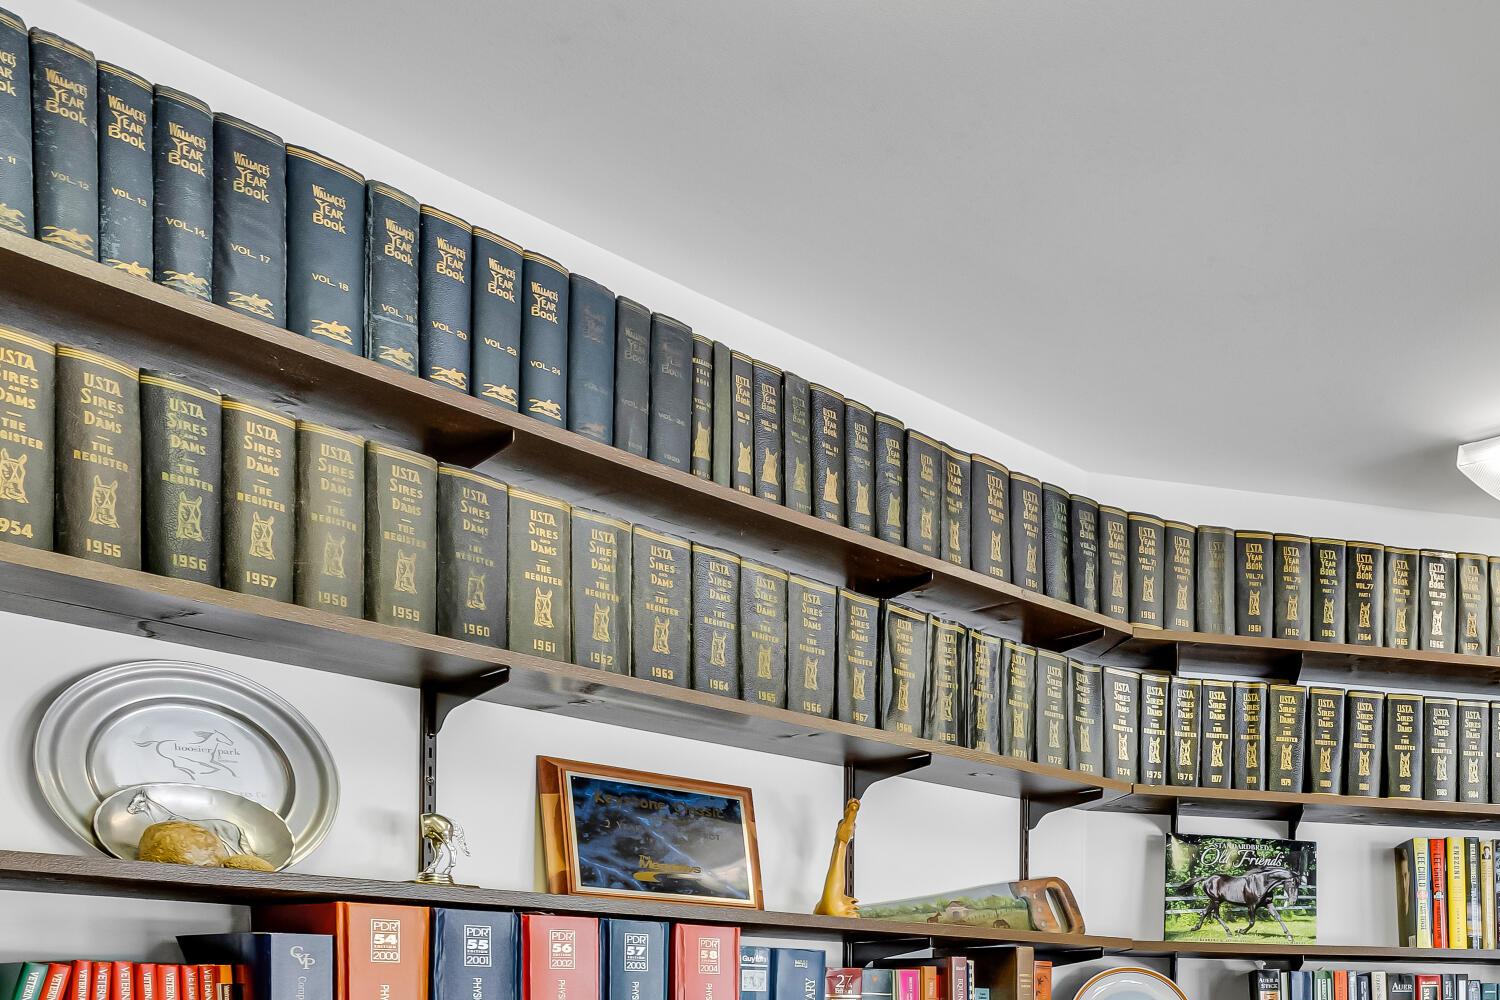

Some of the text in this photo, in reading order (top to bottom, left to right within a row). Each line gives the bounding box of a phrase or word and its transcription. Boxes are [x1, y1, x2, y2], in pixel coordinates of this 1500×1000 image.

[112, 111, 144, 135] YEAR
[108, 123, 145, 151] Book
[236, 166, 267, 188] YEAR
[233, 179, 269, 203] Book
[315, 199, 343, 220] YEAR
[313, 212, 346, 234] Book
[439, 251, 463, 271] YEAR
[436, 261, 465, 283] Book
[533, 295, 556, 312] YEAR
[531, 304, 558, 324] Book
[83, 373, 123, 398] USTA
[80, 388, 124, 414] SIRES
[84, 411, 122, 434] DAMS
[246, 421, 280, 444] USTA
[92, 441, 114, 455] THE
[244, 436, 281, 459] SIRES
[73, 450, 129, 472] REGISTER
[246, 456, 280, 476] DAMS
[392, 465, 422, 485] USTA
[253, 485, 272, 497] THE
[237, 492, 285, 512] REGISTER
[530, 510, 557, 526] USTA
[529, 521, 558, 540] SIRES
[86, 538, 121, 557] 1955
[531, 540, 557, 556] DAMS
[172, 554, 207, 571] 1956
[536, 564, 552, 574] THE
[246, 572, 277, 588] 1957
[393, 606, 420, 622] 1959
[464, 623, 490, 637] 1960
[533, 639, 555, 652] 1961
[652, 667, 673, 680] 1963
[710, 679, 729, 691] 1964
[1177, 773, 1193, 781] 1976
[1233, 850, 1282, 867] Friends
[373, 922, 397, 932] PDR
[467, 928, 488, 937] PDR
[373, 933, 397, 945] 54
[467, 940, 489, 949] 55
[627, 936, 645, 944] PDR
[373, 951, 398, 961] 2000
[552, 944, 572, 952] 56
[627, 947, 644, 955] 57
[701, 951, 717, 959] 58
[467, 956, 488, 964] 2001
[835, 975, 852, 988] 27
